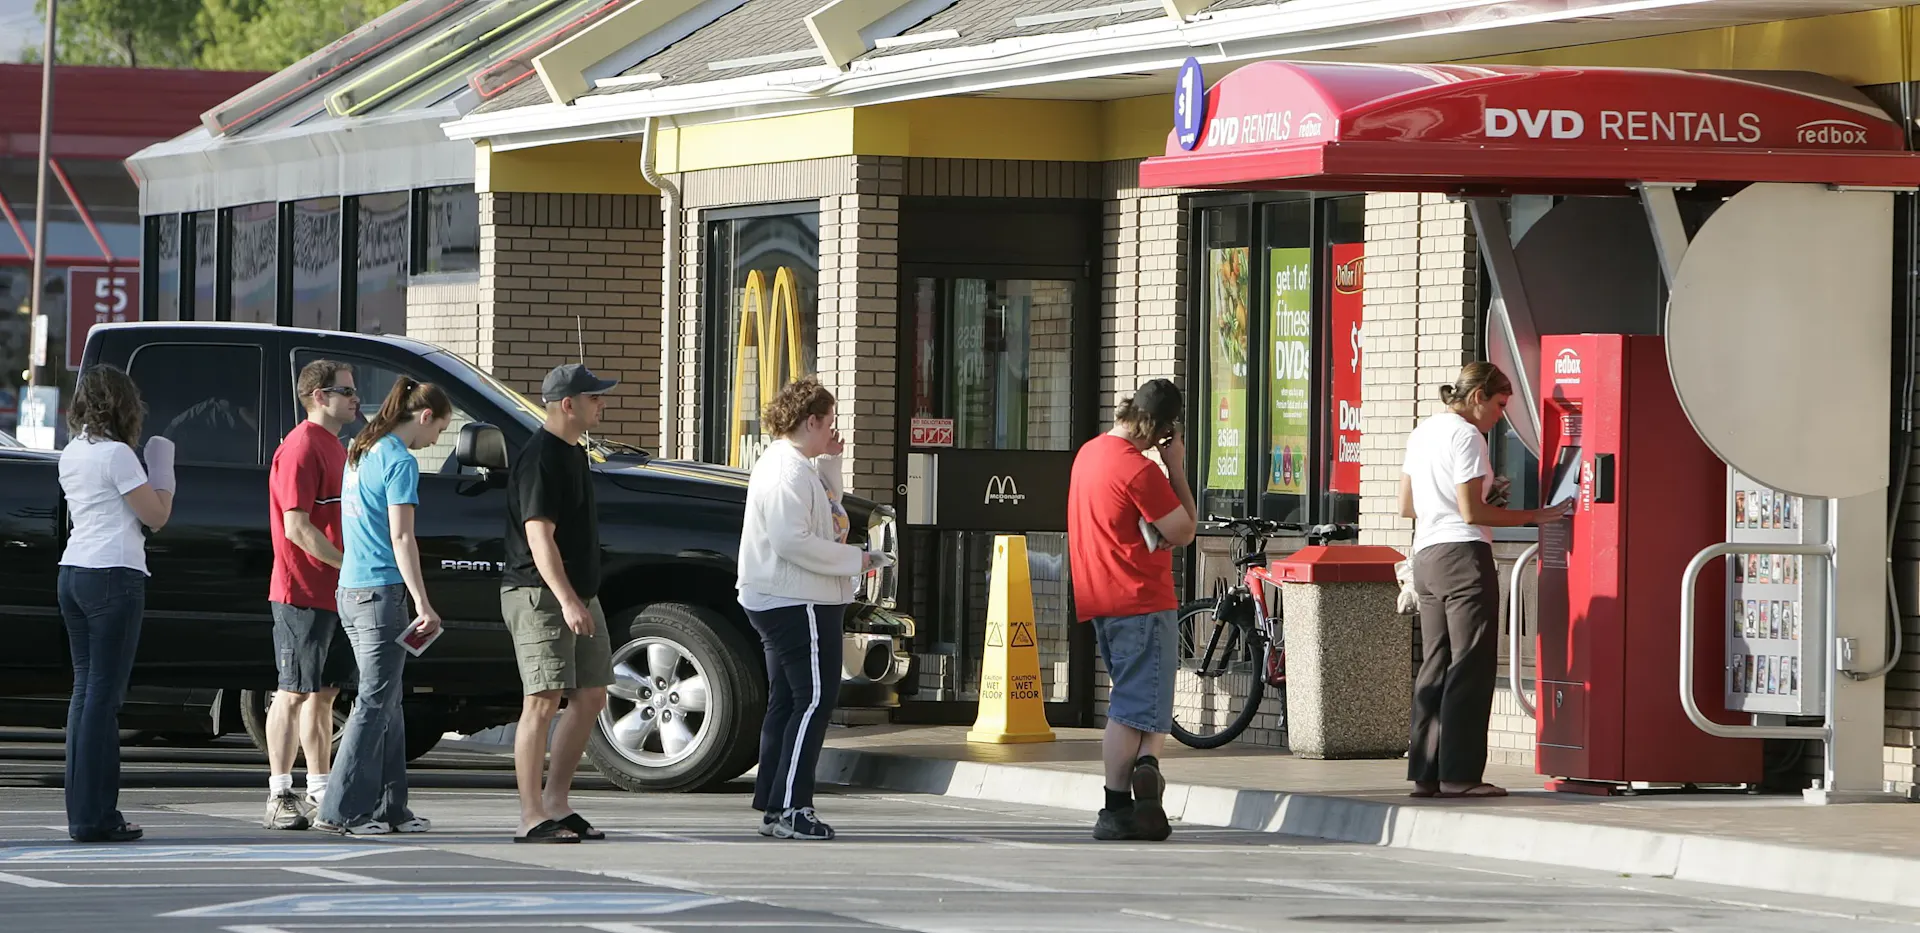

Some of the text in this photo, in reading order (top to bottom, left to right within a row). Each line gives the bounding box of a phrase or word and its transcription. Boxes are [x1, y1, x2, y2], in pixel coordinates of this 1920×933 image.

[1208, 110, 1291, 147] DVD RENTALS
[1299, 119, 1321, 138] redbox
[1485, 108, 1762, 143] DVD RENTALS
[1797, 126, 1868, 144] redbox
[1276, 263, 1308, 296] get 1 of
[1337, 264, 1354, 286] Dollar
[95, 276, 127, 313] 5
[1555, 355, 1581, 374] redbox
[1217, 428, 1239, 447] asian
[1217, 449, 1238, 476] salad
[990, 492, 1025, 500] McDonald's
[441, 559, 491, 571] RAM
[982, 691, 1003, 700] FLOOR
[987, 682, 999, 690] WET
[1010, 690, 1039, 700] FLOOR
[1015, 682, 1033, 690] WET
